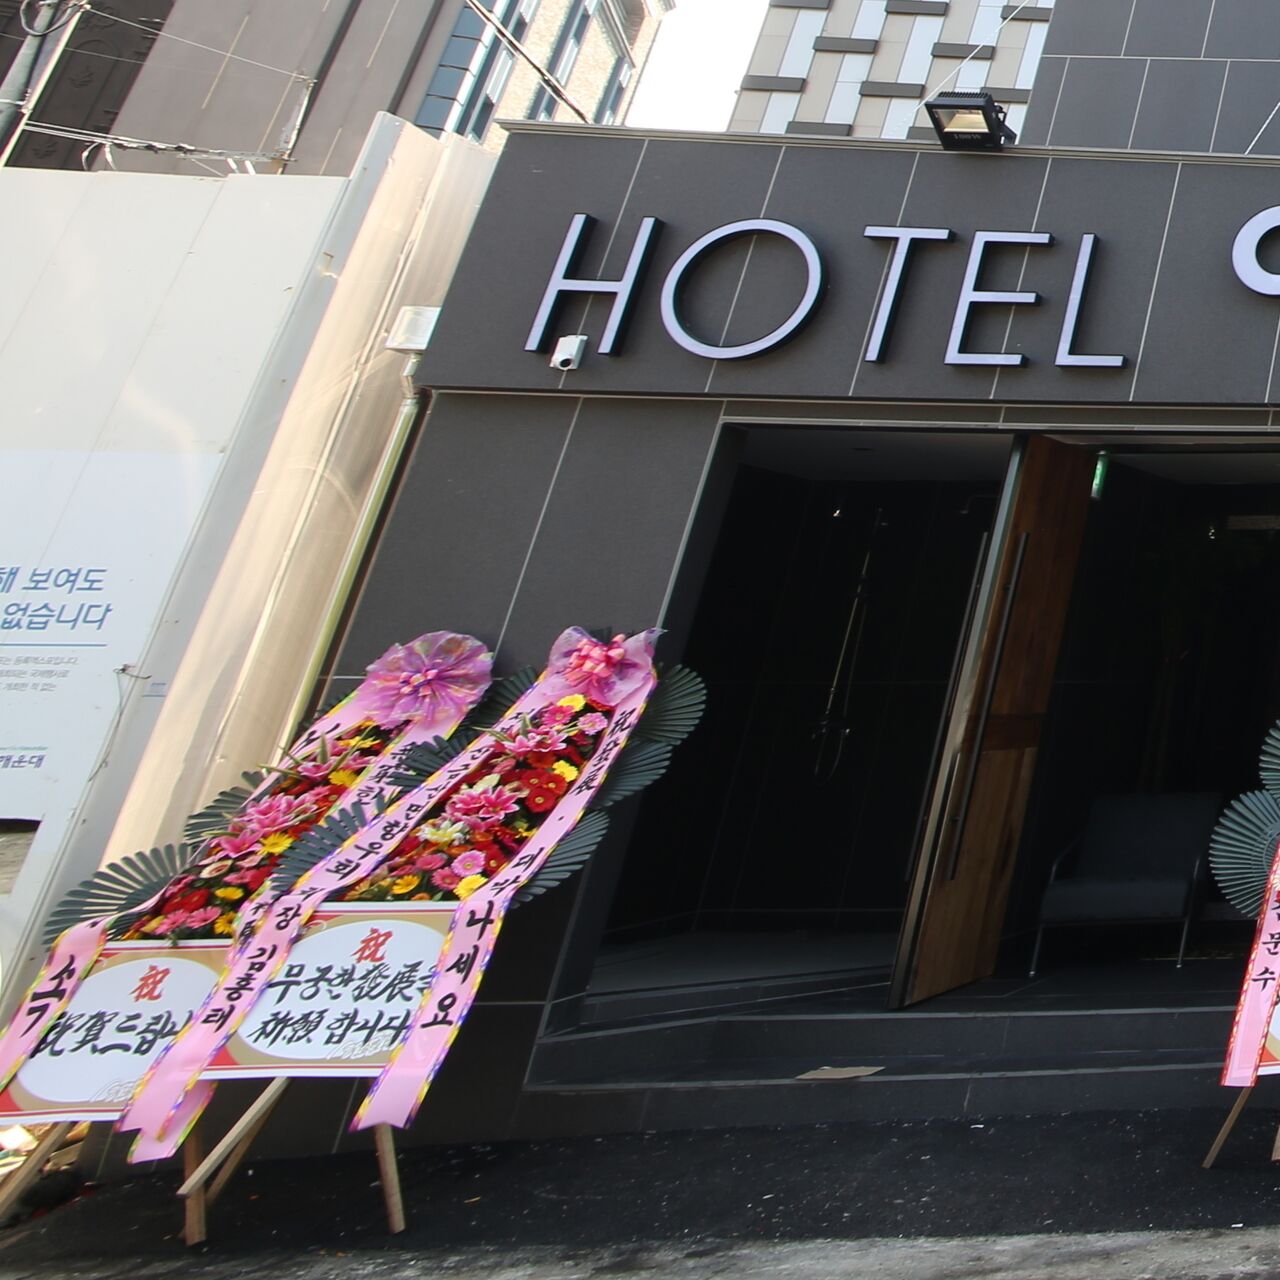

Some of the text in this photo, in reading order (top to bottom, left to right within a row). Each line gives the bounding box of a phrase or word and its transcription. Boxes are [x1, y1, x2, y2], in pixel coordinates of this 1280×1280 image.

[524, 213, 1128, 368] HOTEL
[22, 566, 108, 593] 보여도
[0, 603, 113, 632] 없습니다
[351, 927, 394, 963] 祝
[420, 847, 545, 1030] 대박나세요
[129, 964, 171, 1003] 祝
